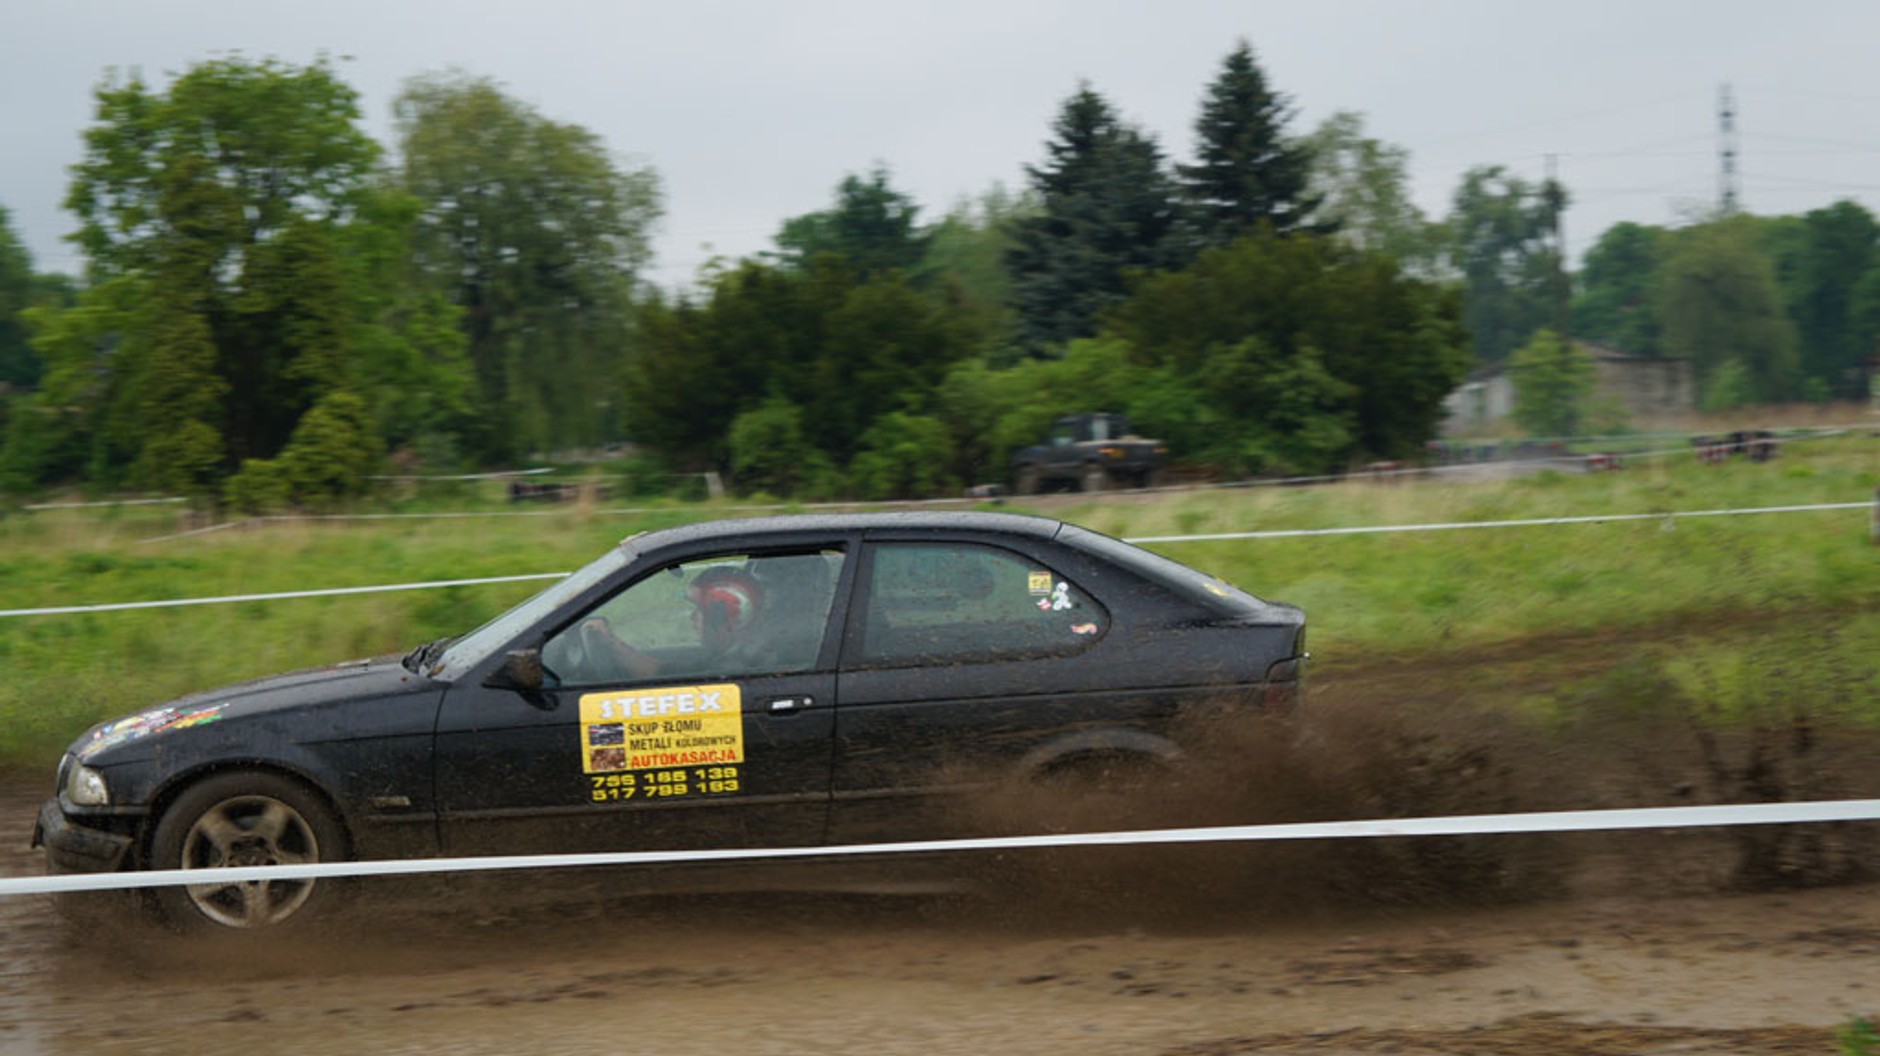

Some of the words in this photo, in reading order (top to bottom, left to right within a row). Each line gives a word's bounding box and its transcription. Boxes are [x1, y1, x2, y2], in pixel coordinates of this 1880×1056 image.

[600, 691, 721, 718] STEFEX
[628, 723, 659, 736] SKUP
[629, 738, 672, 751] METALI
[675, 735, 737, 748] KOLOROWYCH
[631, 749, 737, 769] AUTOKASACJA
